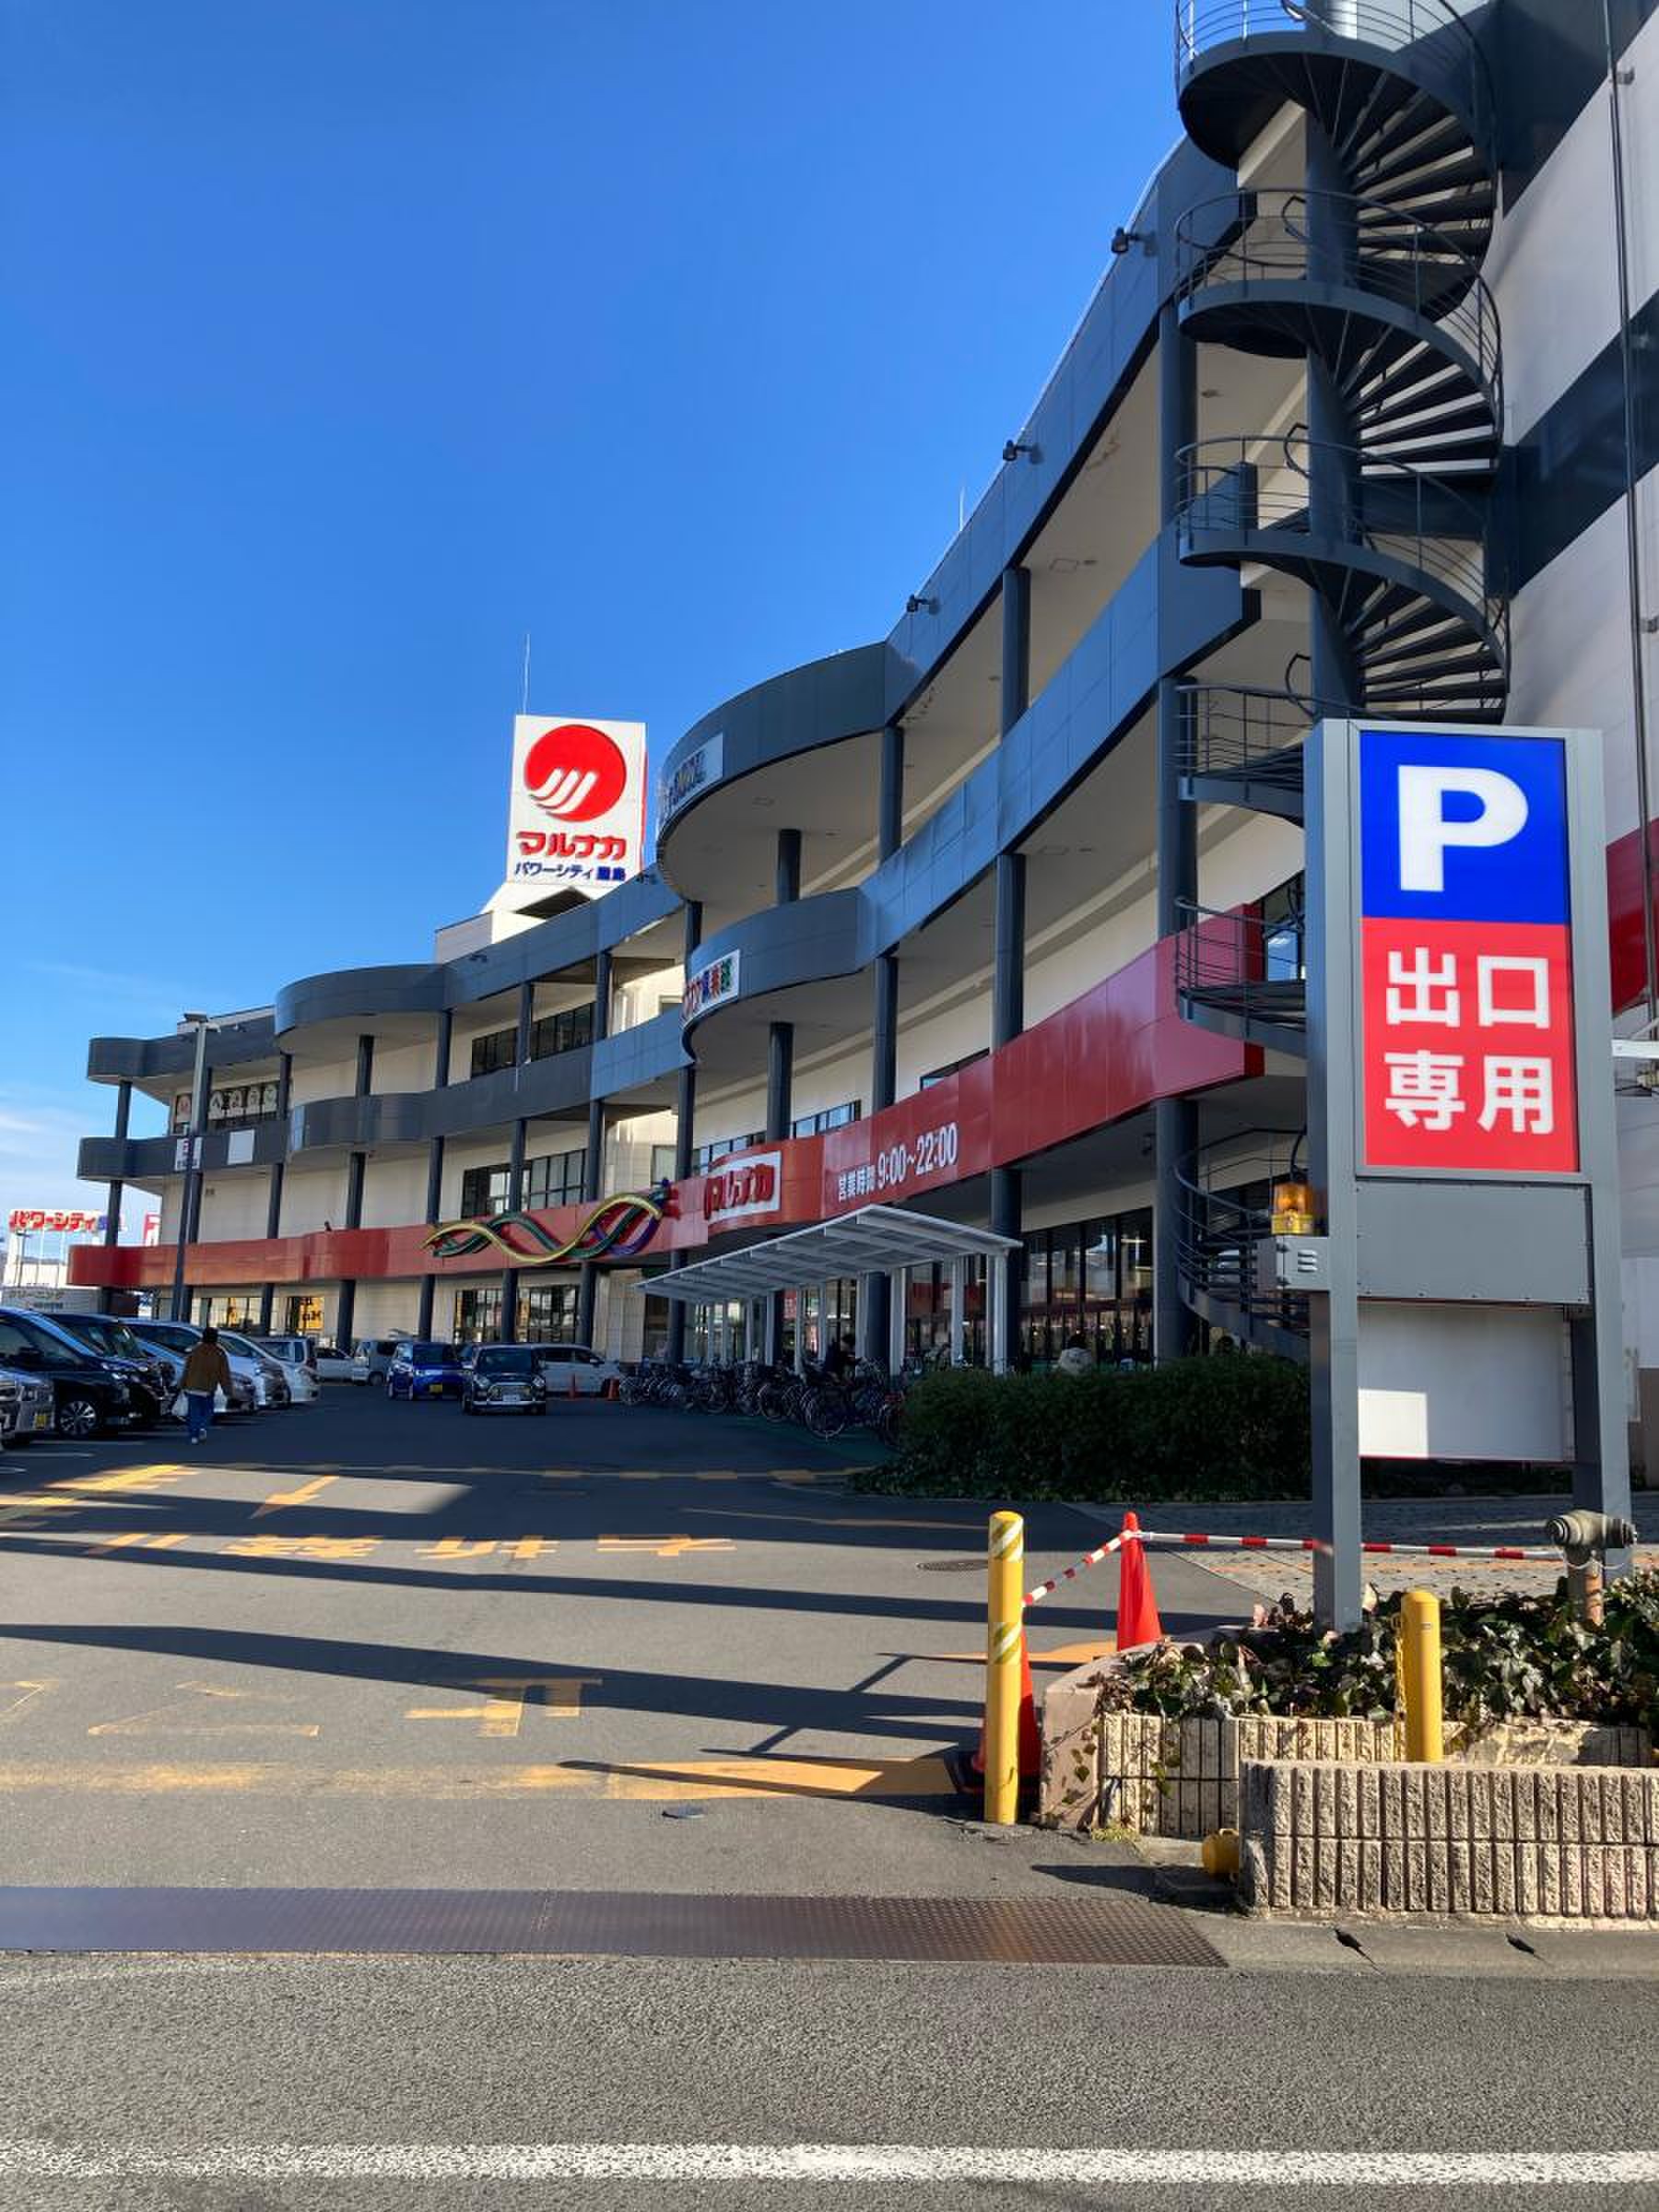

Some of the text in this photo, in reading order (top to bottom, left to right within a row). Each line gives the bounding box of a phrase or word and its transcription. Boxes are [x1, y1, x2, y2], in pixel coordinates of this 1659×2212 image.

[516, 830, 627, 861] マルナカ
[1397, 764, 1529, 892] P
[1385, 947, 1550, 1030] 出口
[1383, 1050, 1555, 1135] 専用
[8, 1210, 110, 1232] パワーシティ
